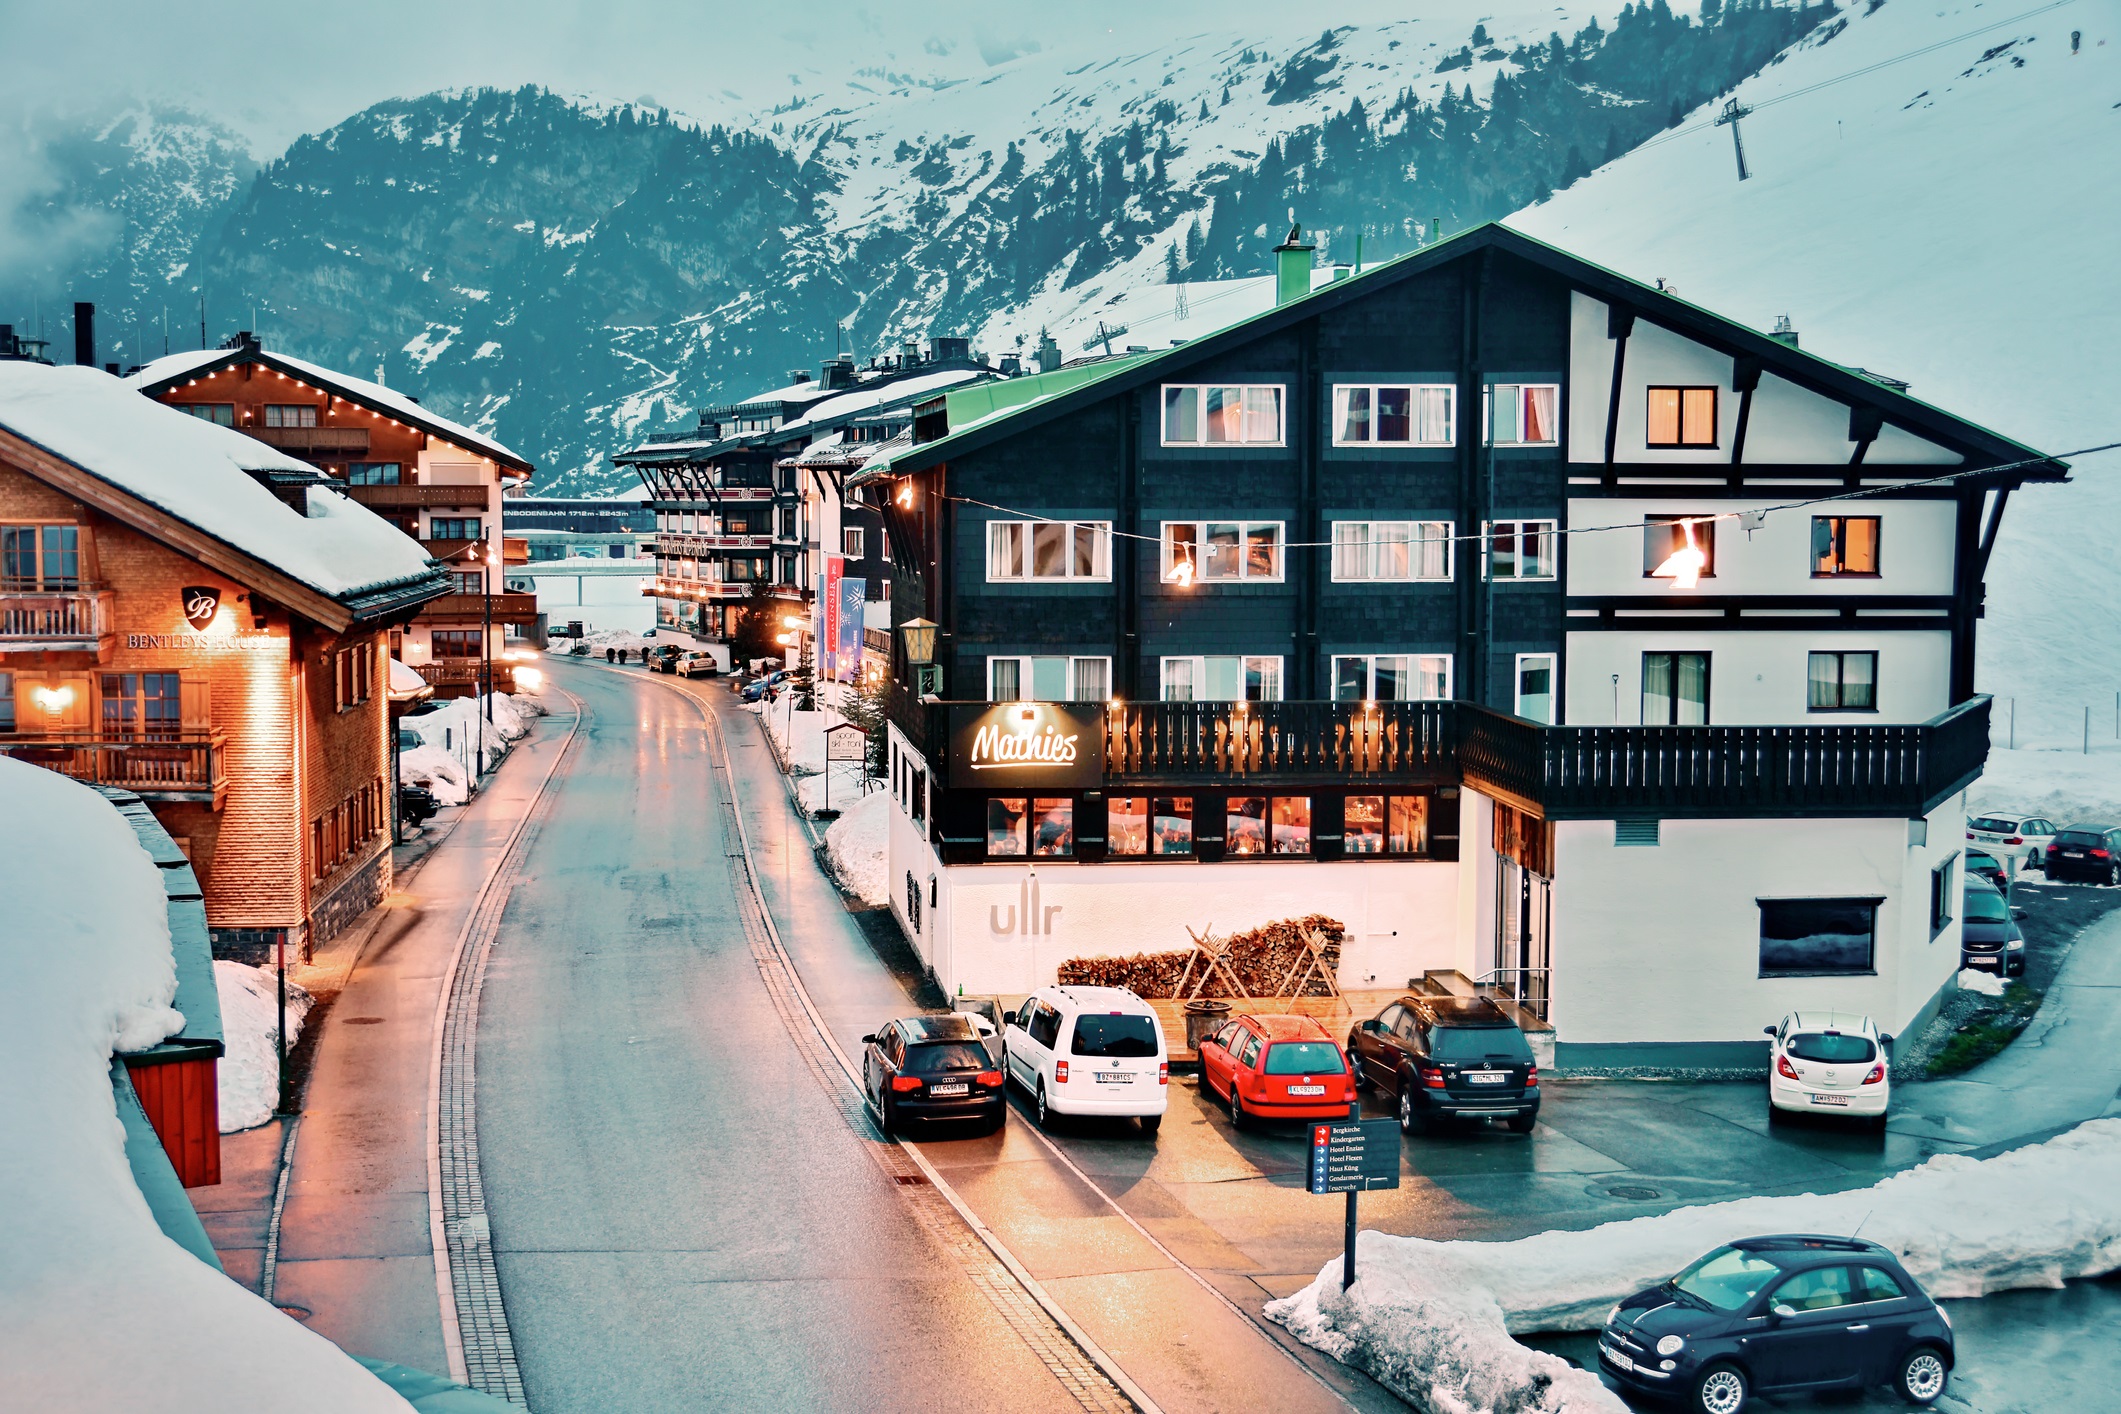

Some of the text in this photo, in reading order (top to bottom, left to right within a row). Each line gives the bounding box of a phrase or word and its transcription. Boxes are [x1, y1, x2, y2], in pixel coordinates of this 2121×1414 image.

[188, 591, 216, 620] B
[127, 634, 271, 650] BENTLEYS HOUSE
[971, 724, 1079, 763] Mathies
[990, 879, 1063, 935] ullr
[1332, 1126, 1361, 1134] Bergkirche
[1328, 1174, 1364, 1182] Gendarmerie
[1328, 1183, 1357, 1191] Feuerwehr
